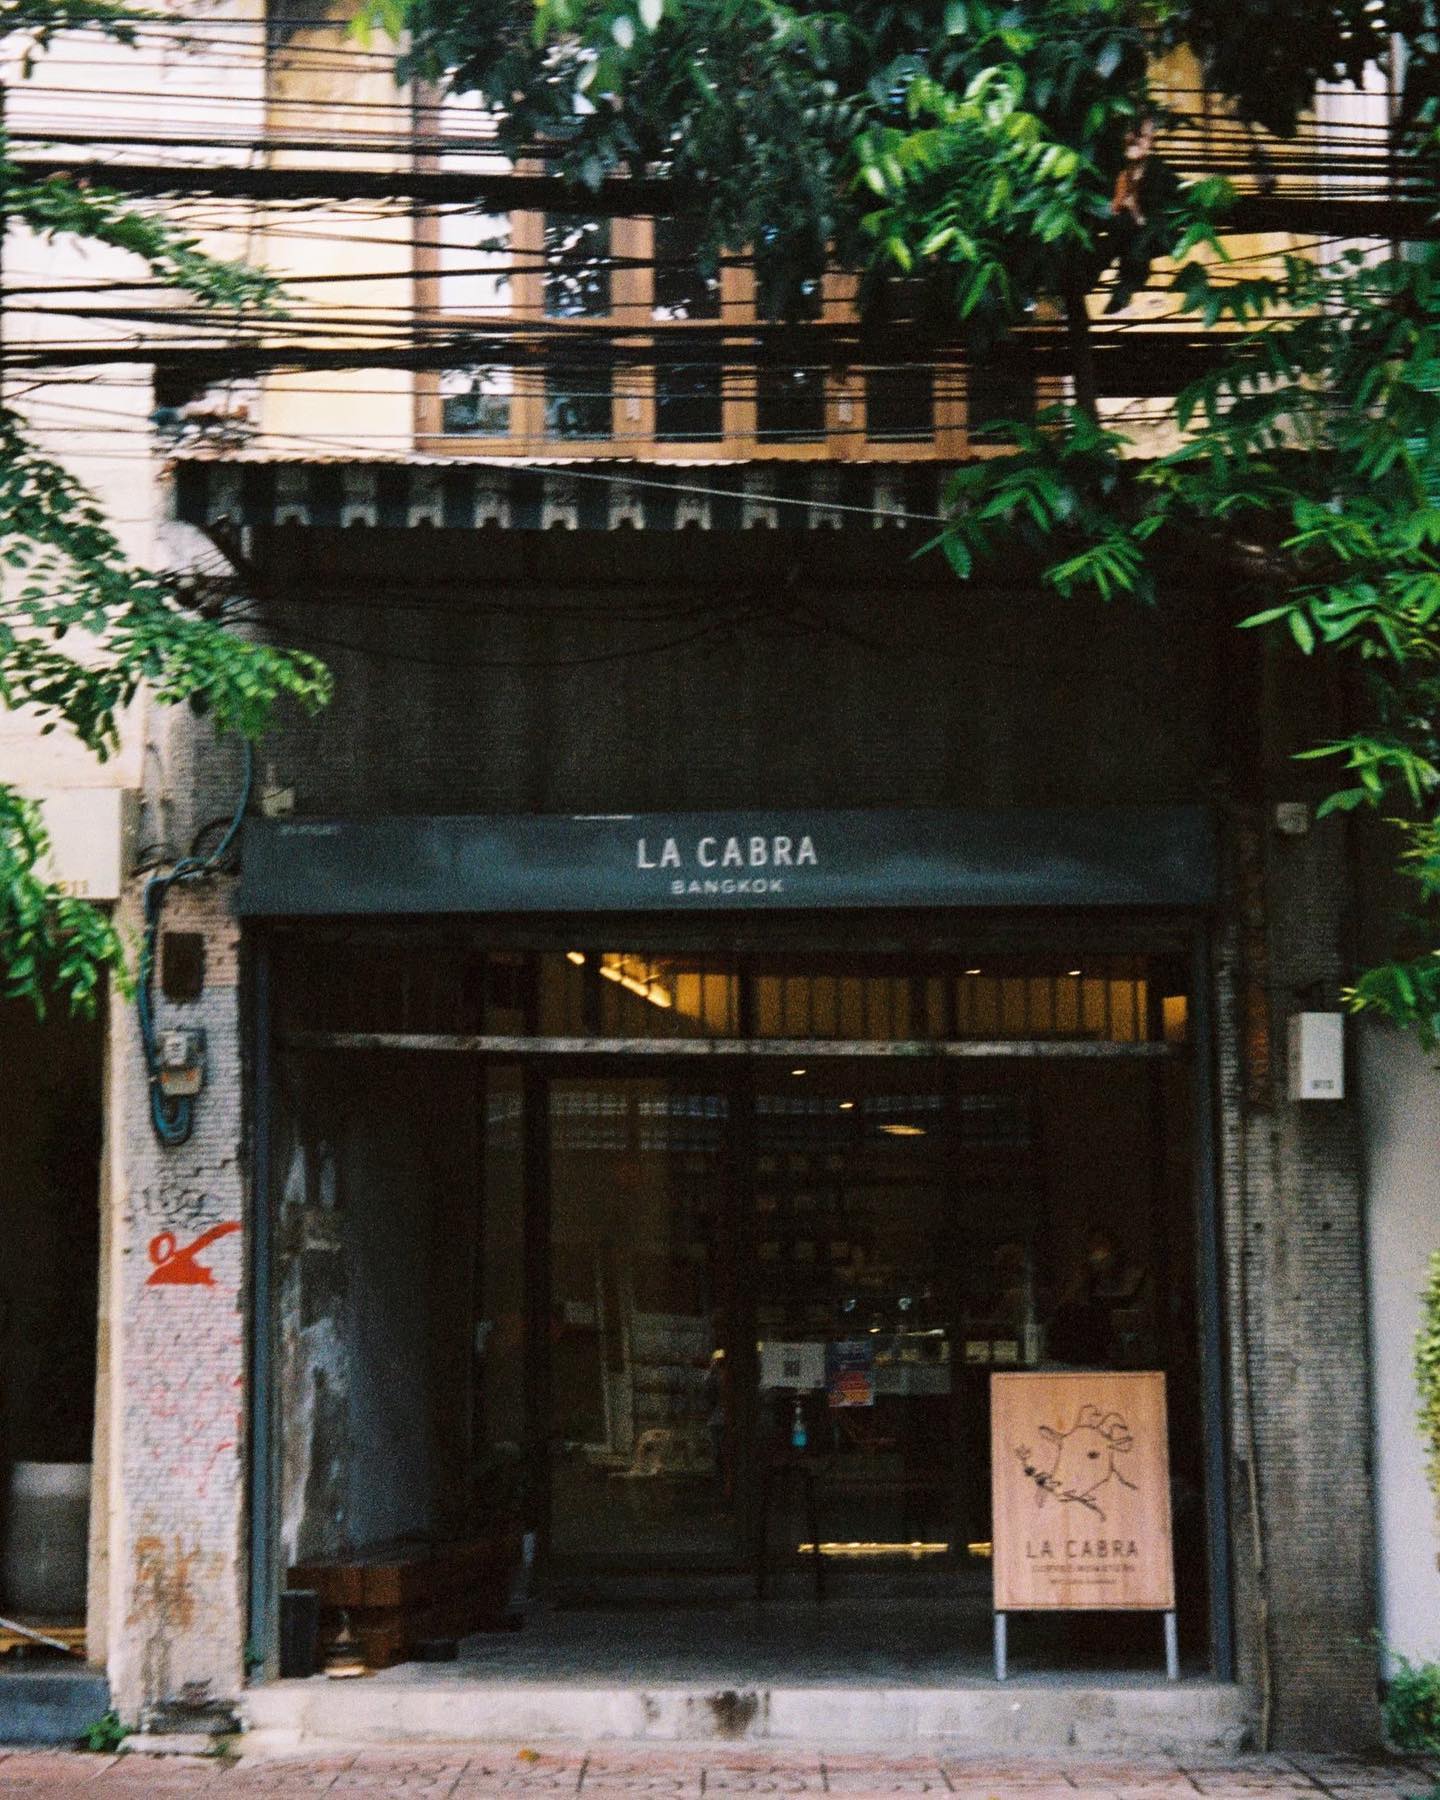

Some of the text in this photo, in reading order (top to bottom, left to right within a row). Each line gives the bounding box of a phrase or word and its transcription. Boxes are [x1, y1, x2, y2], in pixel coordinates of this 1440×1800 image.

[637, 836, 818, 868] LA CABRA
[671, 879, 784, 895] BANGKOK
[1025, 1539, 1138, 1558] LA CABRA
